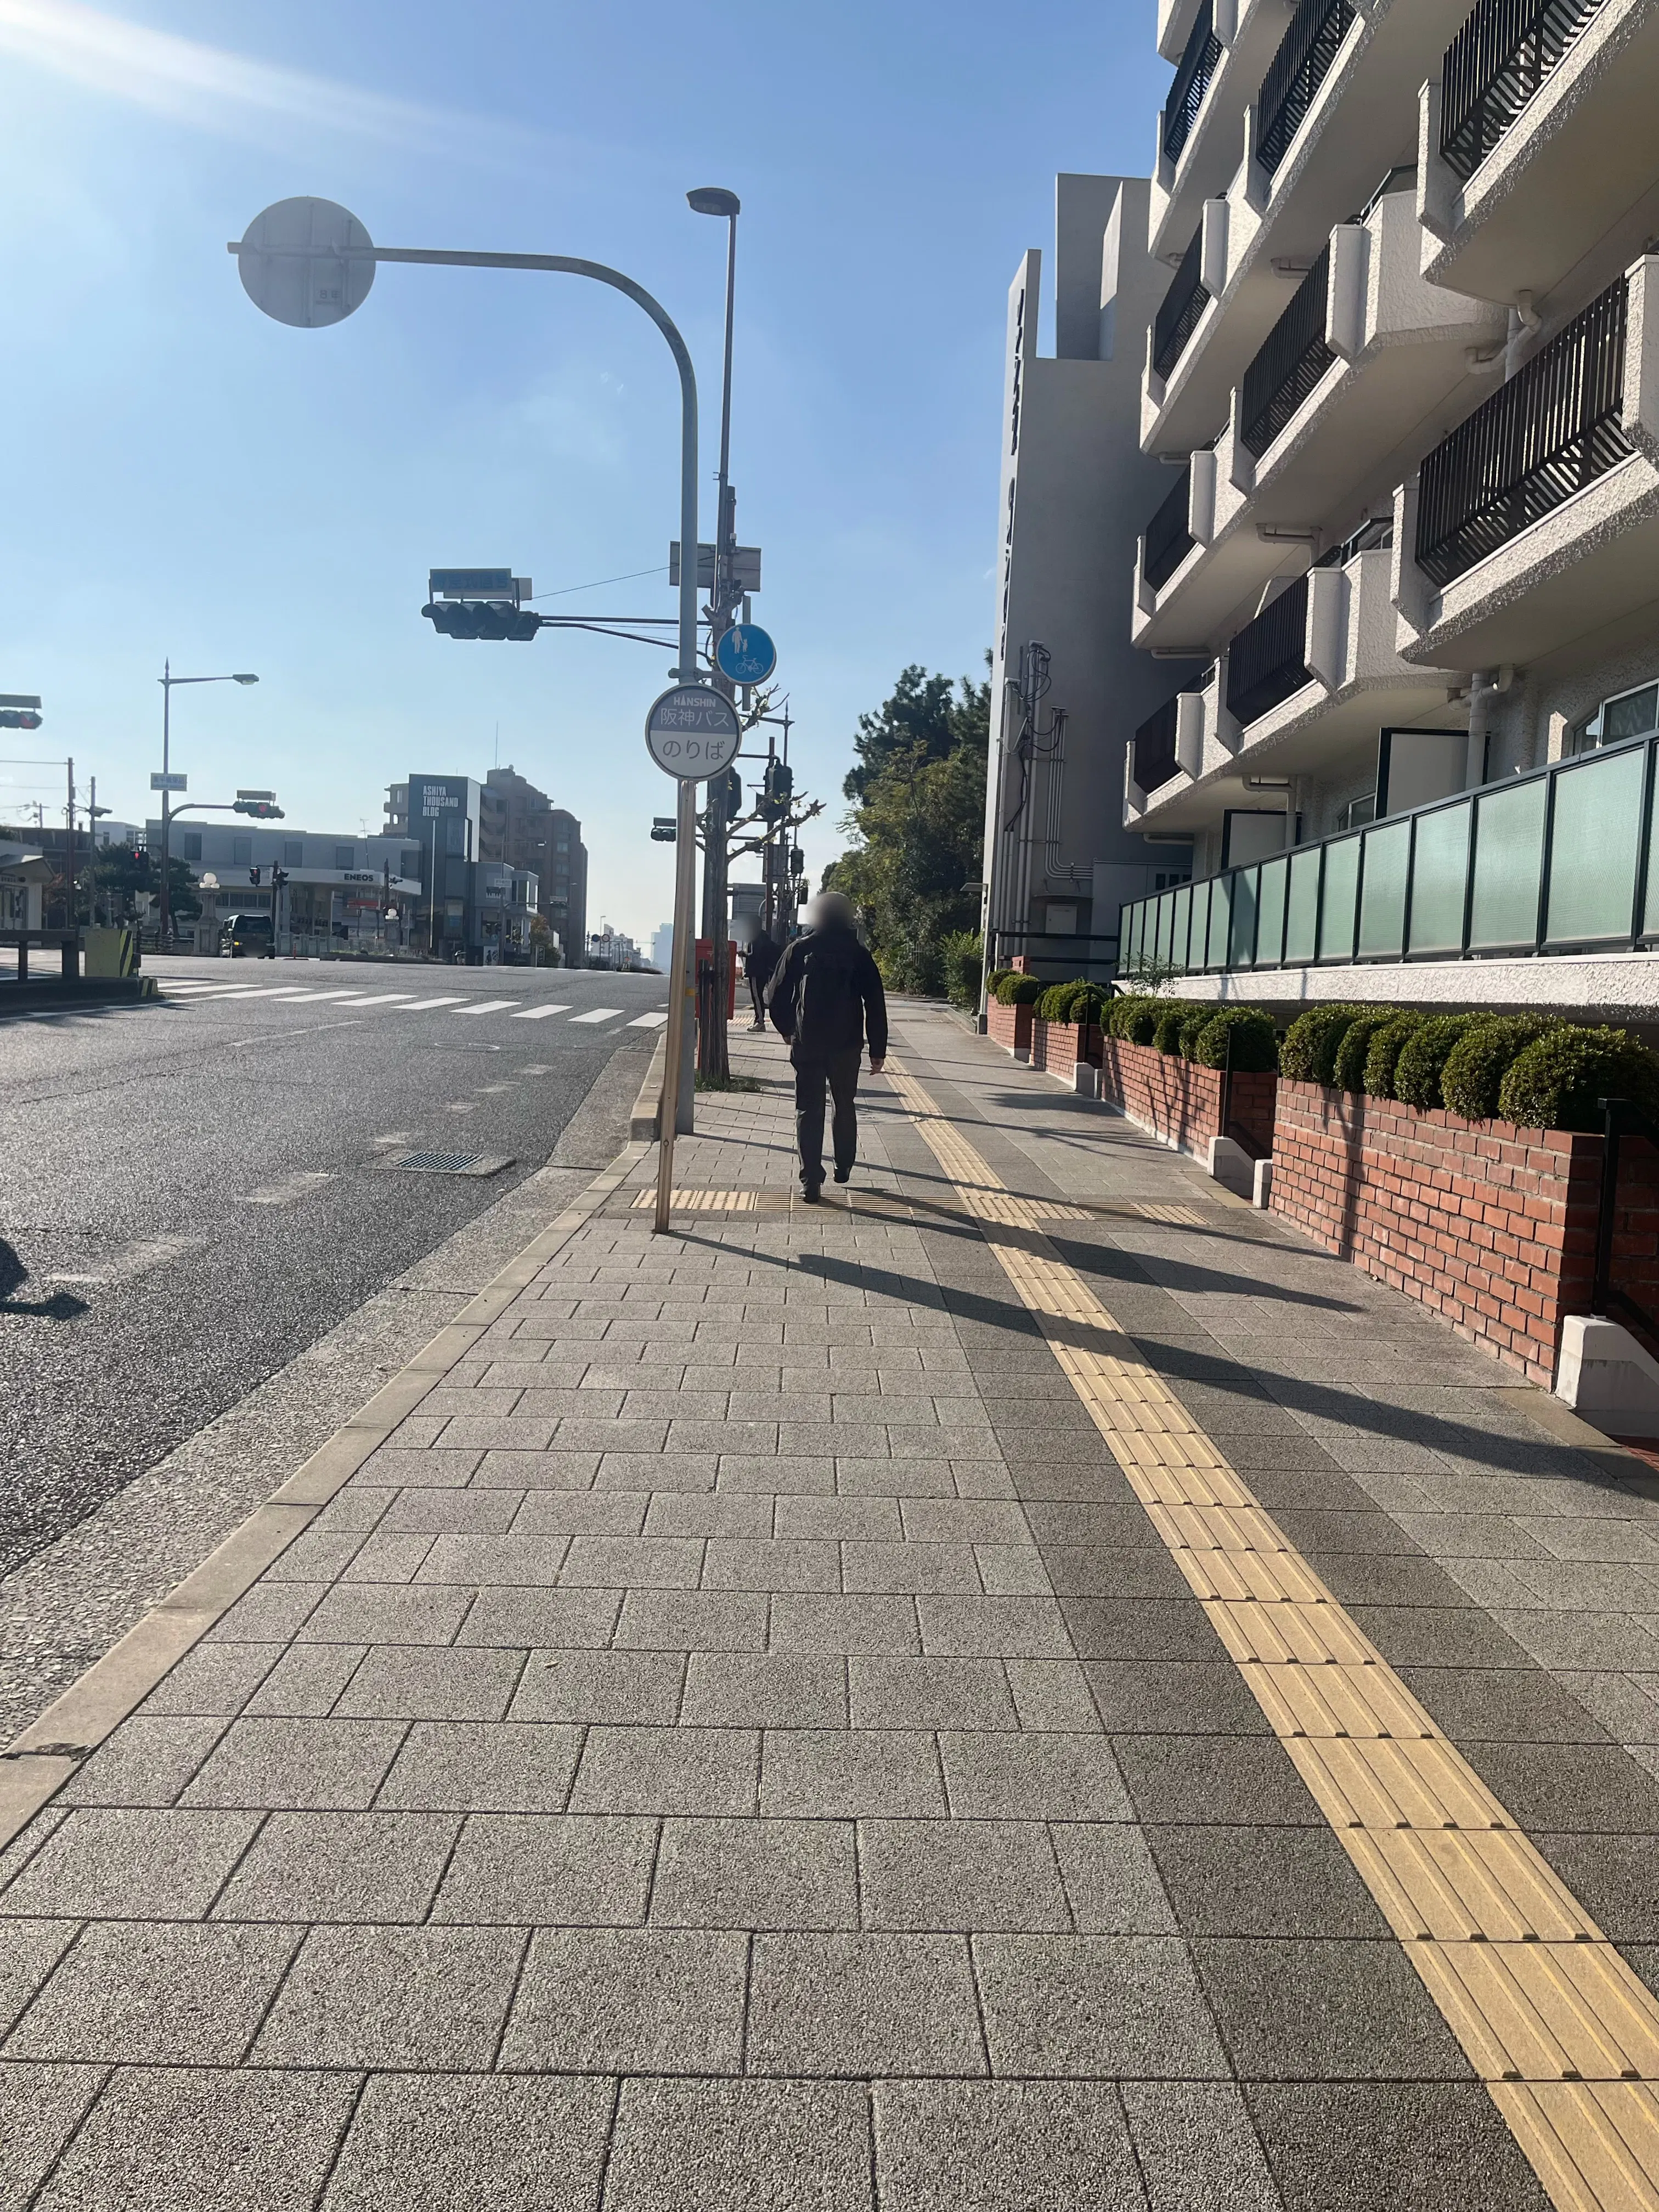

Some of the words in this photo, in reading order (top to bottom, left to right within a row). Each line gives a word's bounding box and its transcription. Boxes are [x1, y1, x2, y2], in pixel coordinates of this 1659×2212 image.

[673, 695, 716, 707] HANSHIN
[661, 708, 729, 727] 阪神バス
[663, 740, 725, 760] のりば
[422, 785, 447, 797] ASHIYA
[423, 795, 459, 808] THOUSAND
[422, 806, 439, 817] BLOG
[344, 873, 374, 882] ENEOS
